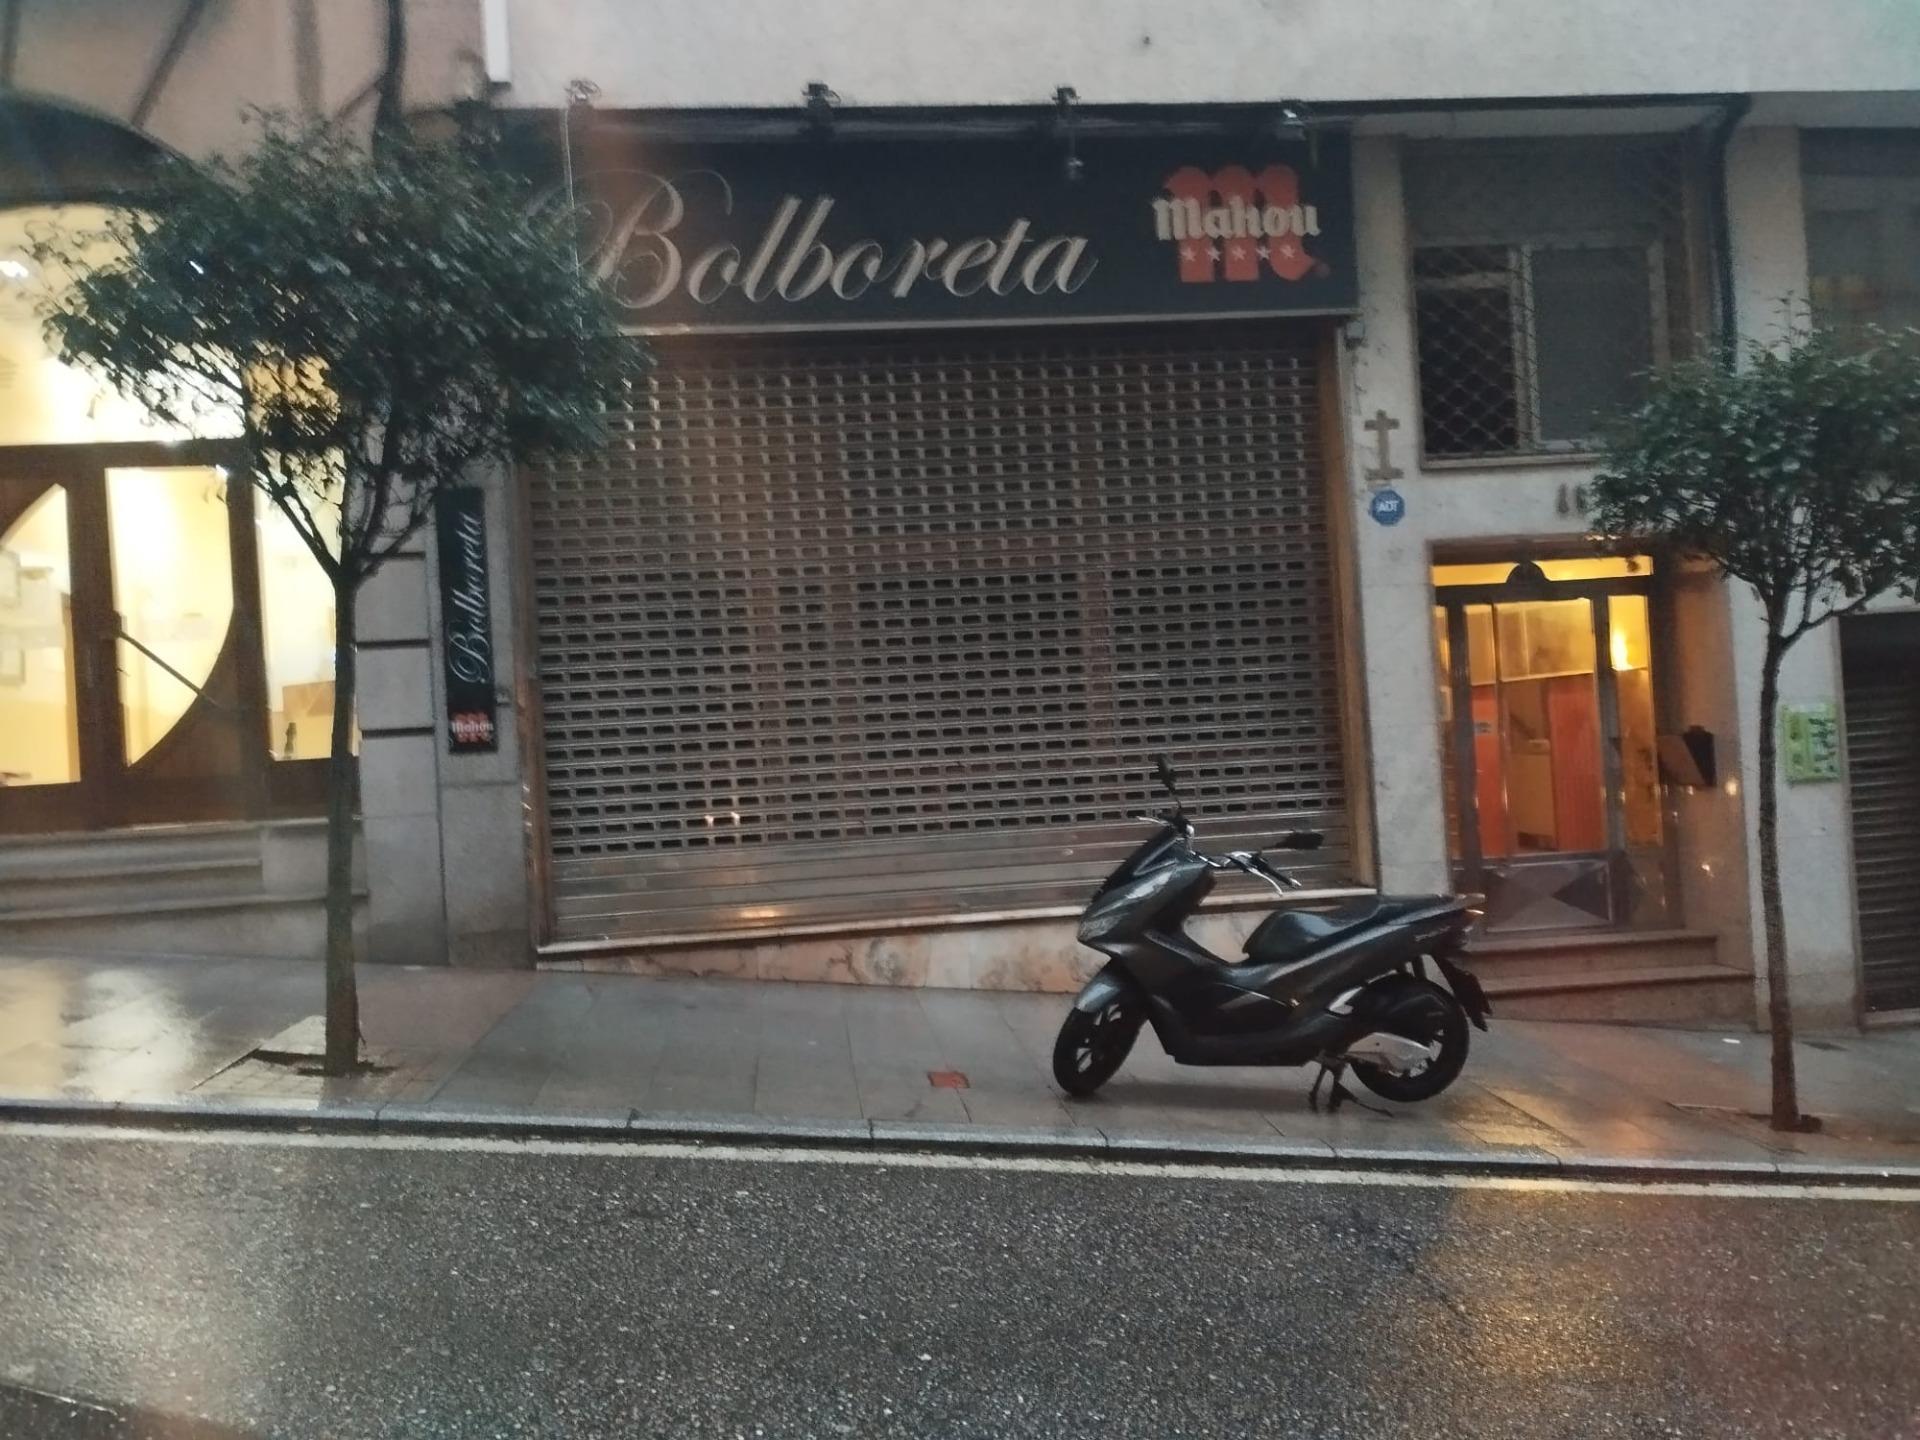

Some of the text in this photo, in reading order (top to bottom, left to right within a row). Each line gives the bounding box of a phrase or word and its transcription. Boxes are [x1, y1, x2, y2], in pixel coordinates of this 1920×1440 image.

[570, 168, 1100, 309] Bolboreta
[1152, 195, 1321, 240] Mahou
[450, 511, 491, 684] Bolboreta
